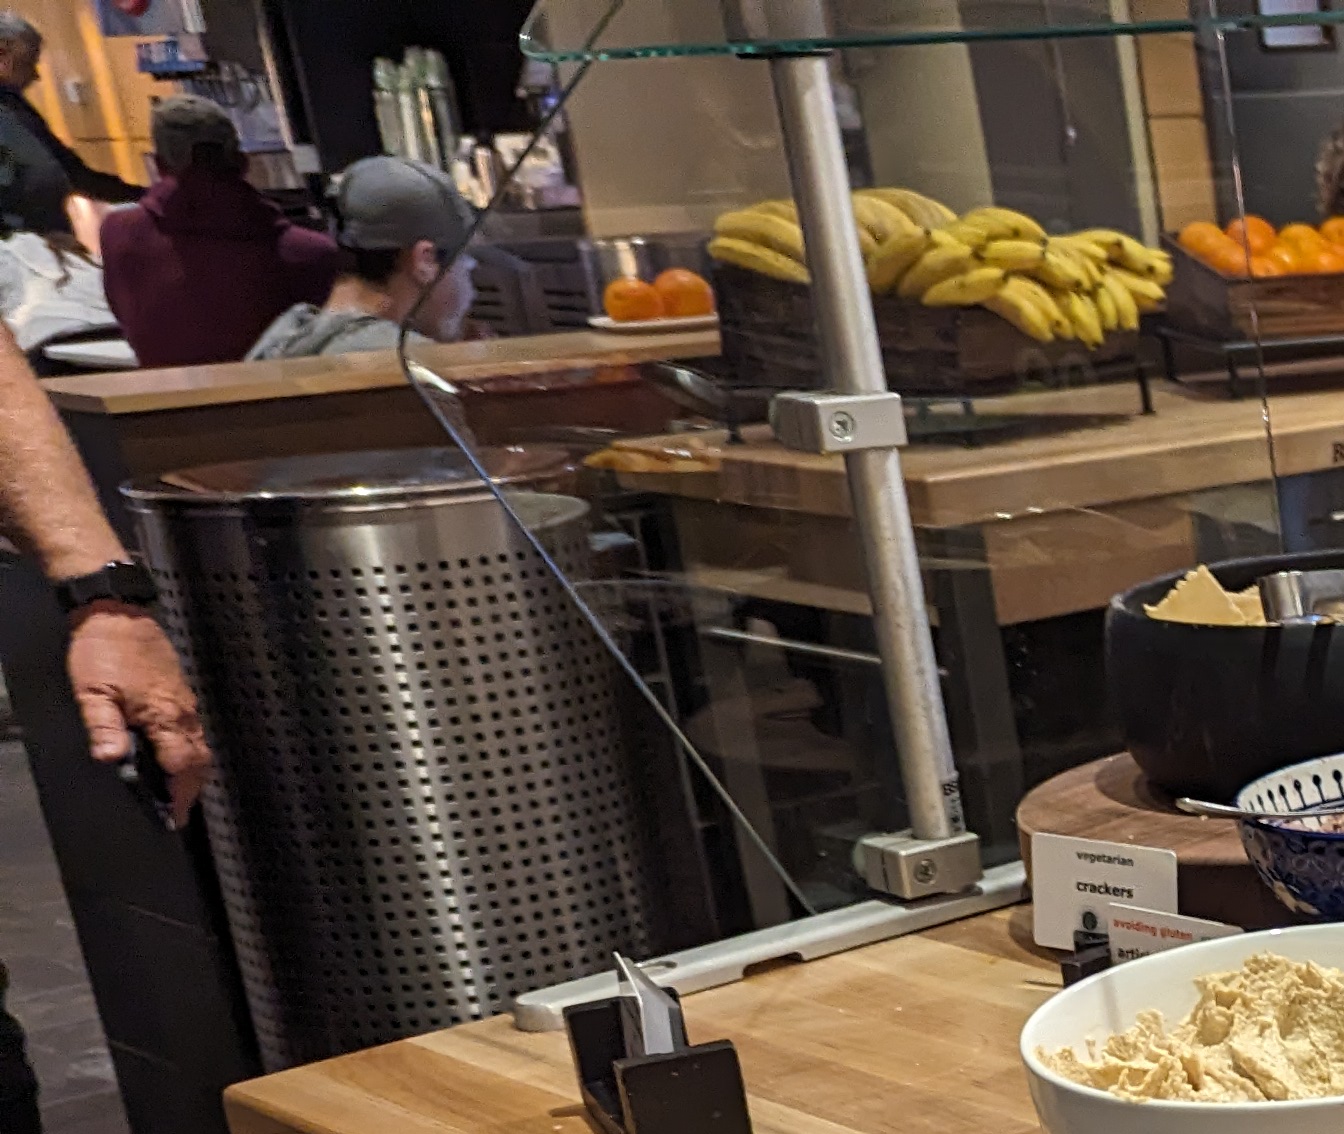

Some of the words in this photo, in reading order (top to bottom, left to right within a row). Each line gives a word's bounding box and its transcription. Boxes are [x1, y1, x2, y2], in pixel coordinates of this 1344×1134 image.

[1076, 851, 1134, 867] vegetarian
[1076, 881, 1134, 899] crackers
[1113, 918, 1157, 937] avoiding
[1159, 927, 1193, 941] gluten
